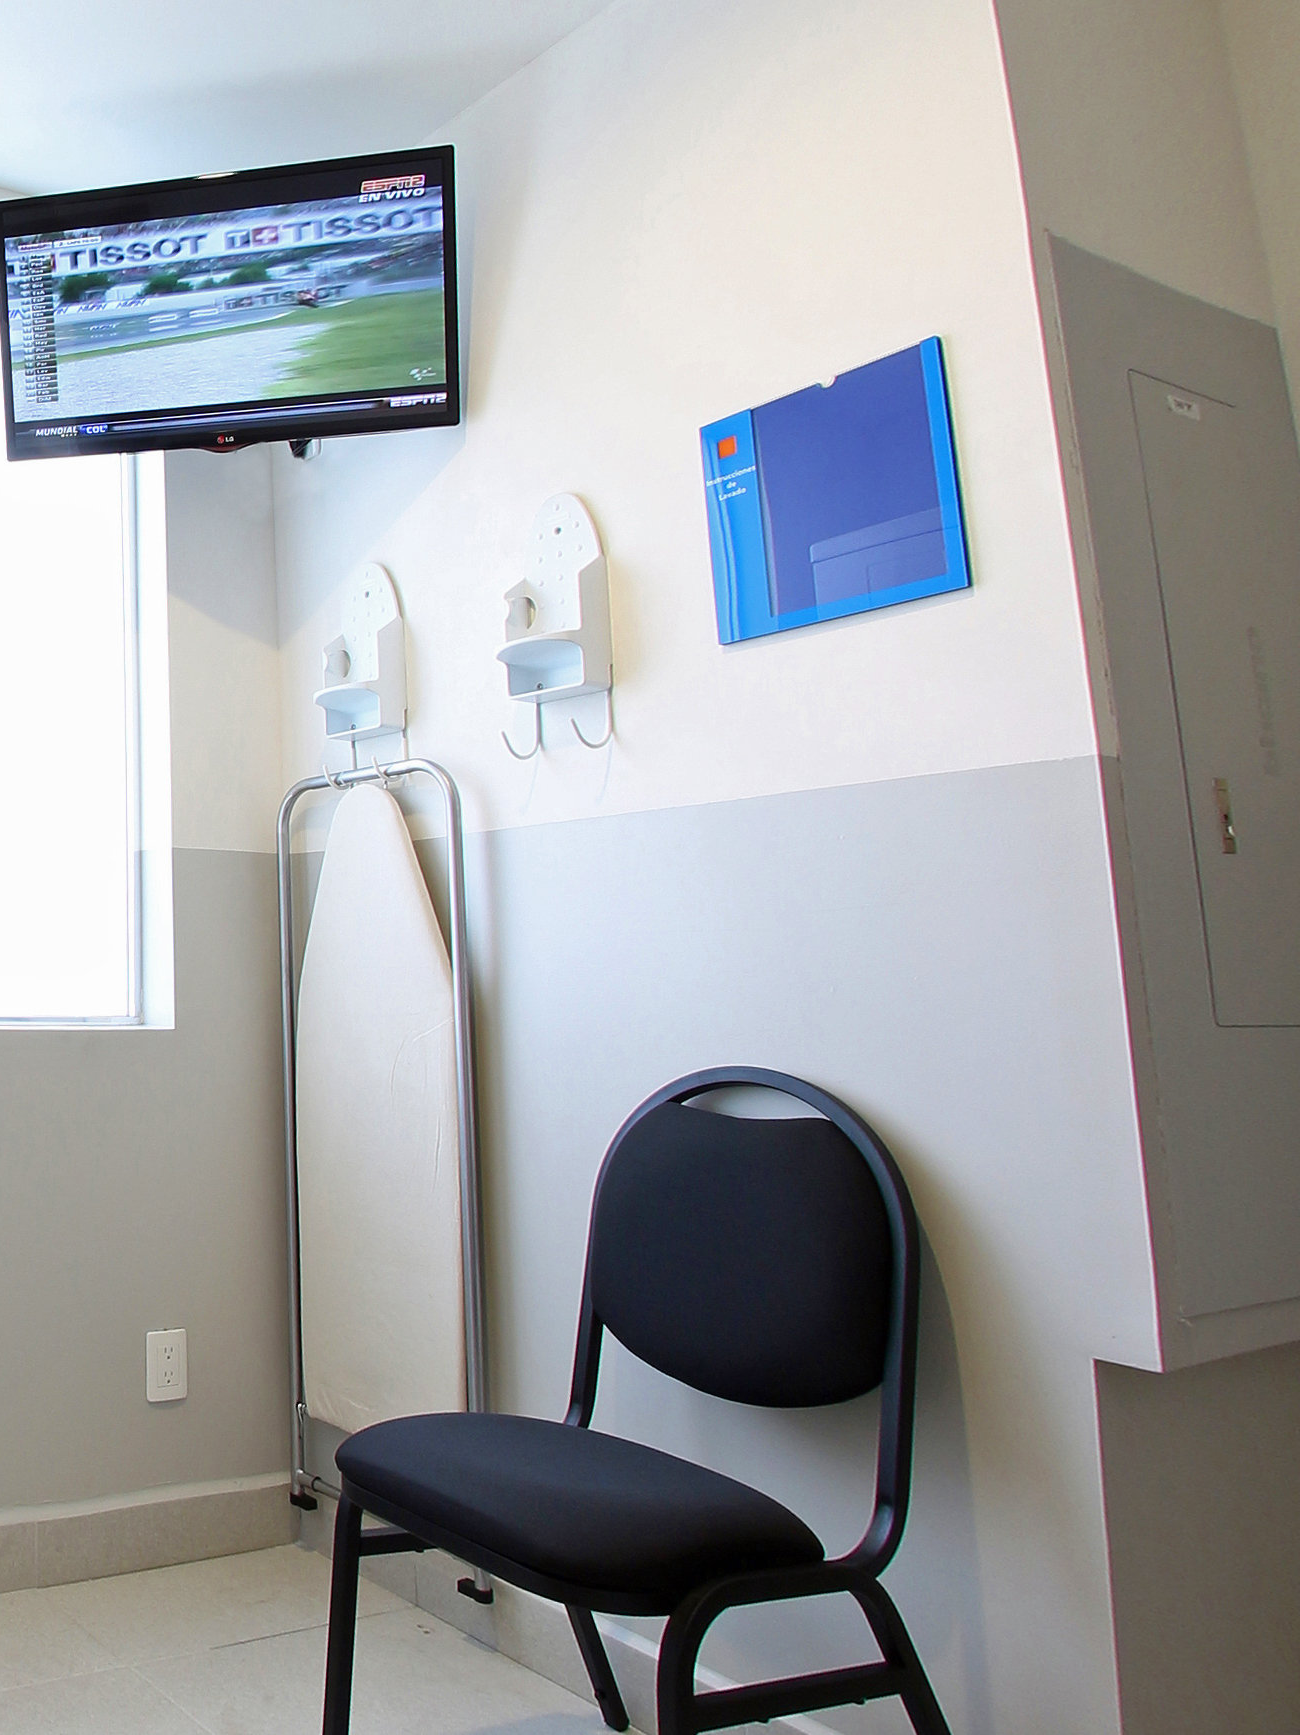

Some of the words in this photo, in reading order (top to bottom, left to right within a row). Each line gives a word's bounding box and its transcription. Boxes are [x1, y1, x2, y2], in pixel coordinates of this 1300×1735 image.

[360, 174, 426, 193] ESPN2
[358, 194, 381, 203] EN
[382, 188, 425, 200] VIVO
[283, 206, 442, 242] TISSOT
[59, 233, 208, 271] TISSOT
[256, 284, 350, 306] TISOT
[390, 392, 448, 408] ESPN2
[35, 426, 78, 437] MUNDIAL
[705, 465, 756, 487] Instrucciones
[726, 481, 737, 489] de
[718, 487, 747, 501] Lavado
